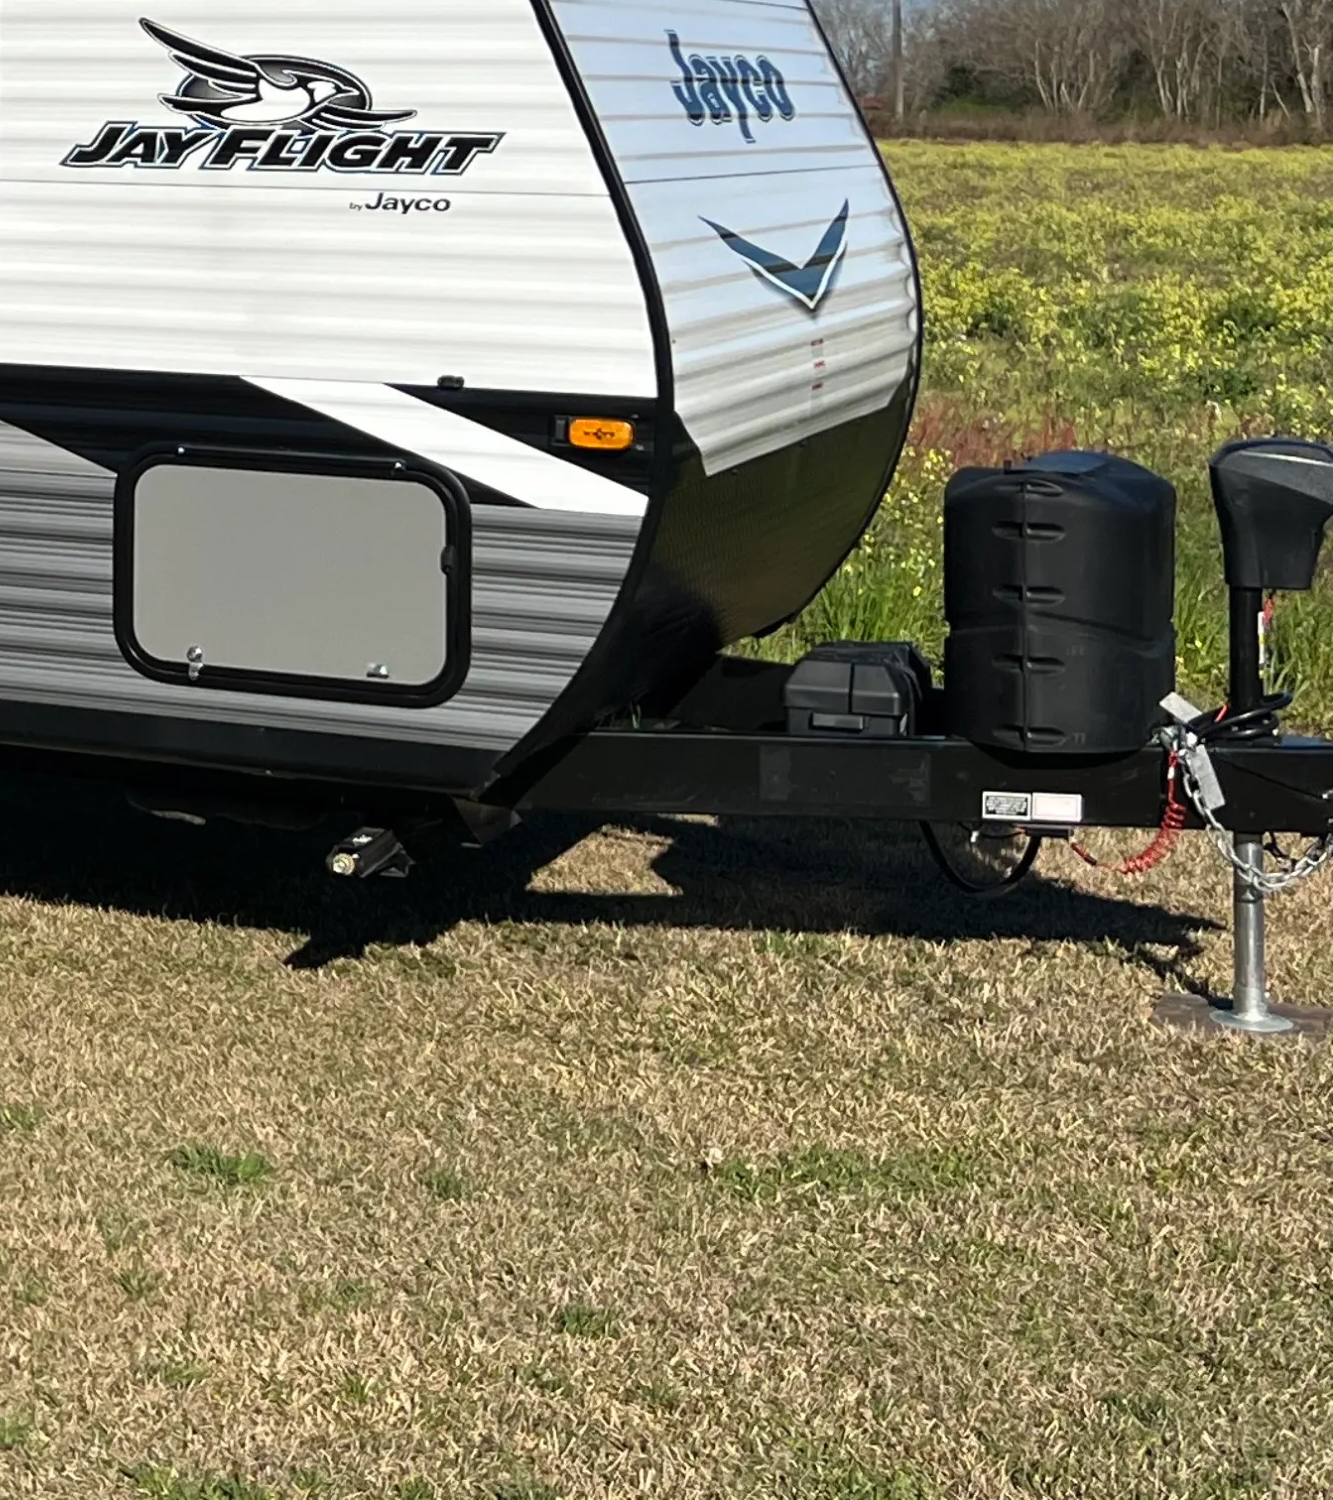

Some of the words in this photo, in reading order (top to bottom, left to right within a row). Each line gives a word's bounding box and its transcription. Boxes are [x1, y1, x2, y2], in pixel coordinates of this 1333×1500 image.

[663, 29, 796, 143] Jayco
[59, 120, 221, 169] JAY
[200, 126, 507, 176] FLIGHT
[365, 192, 452, 215] Jayco
